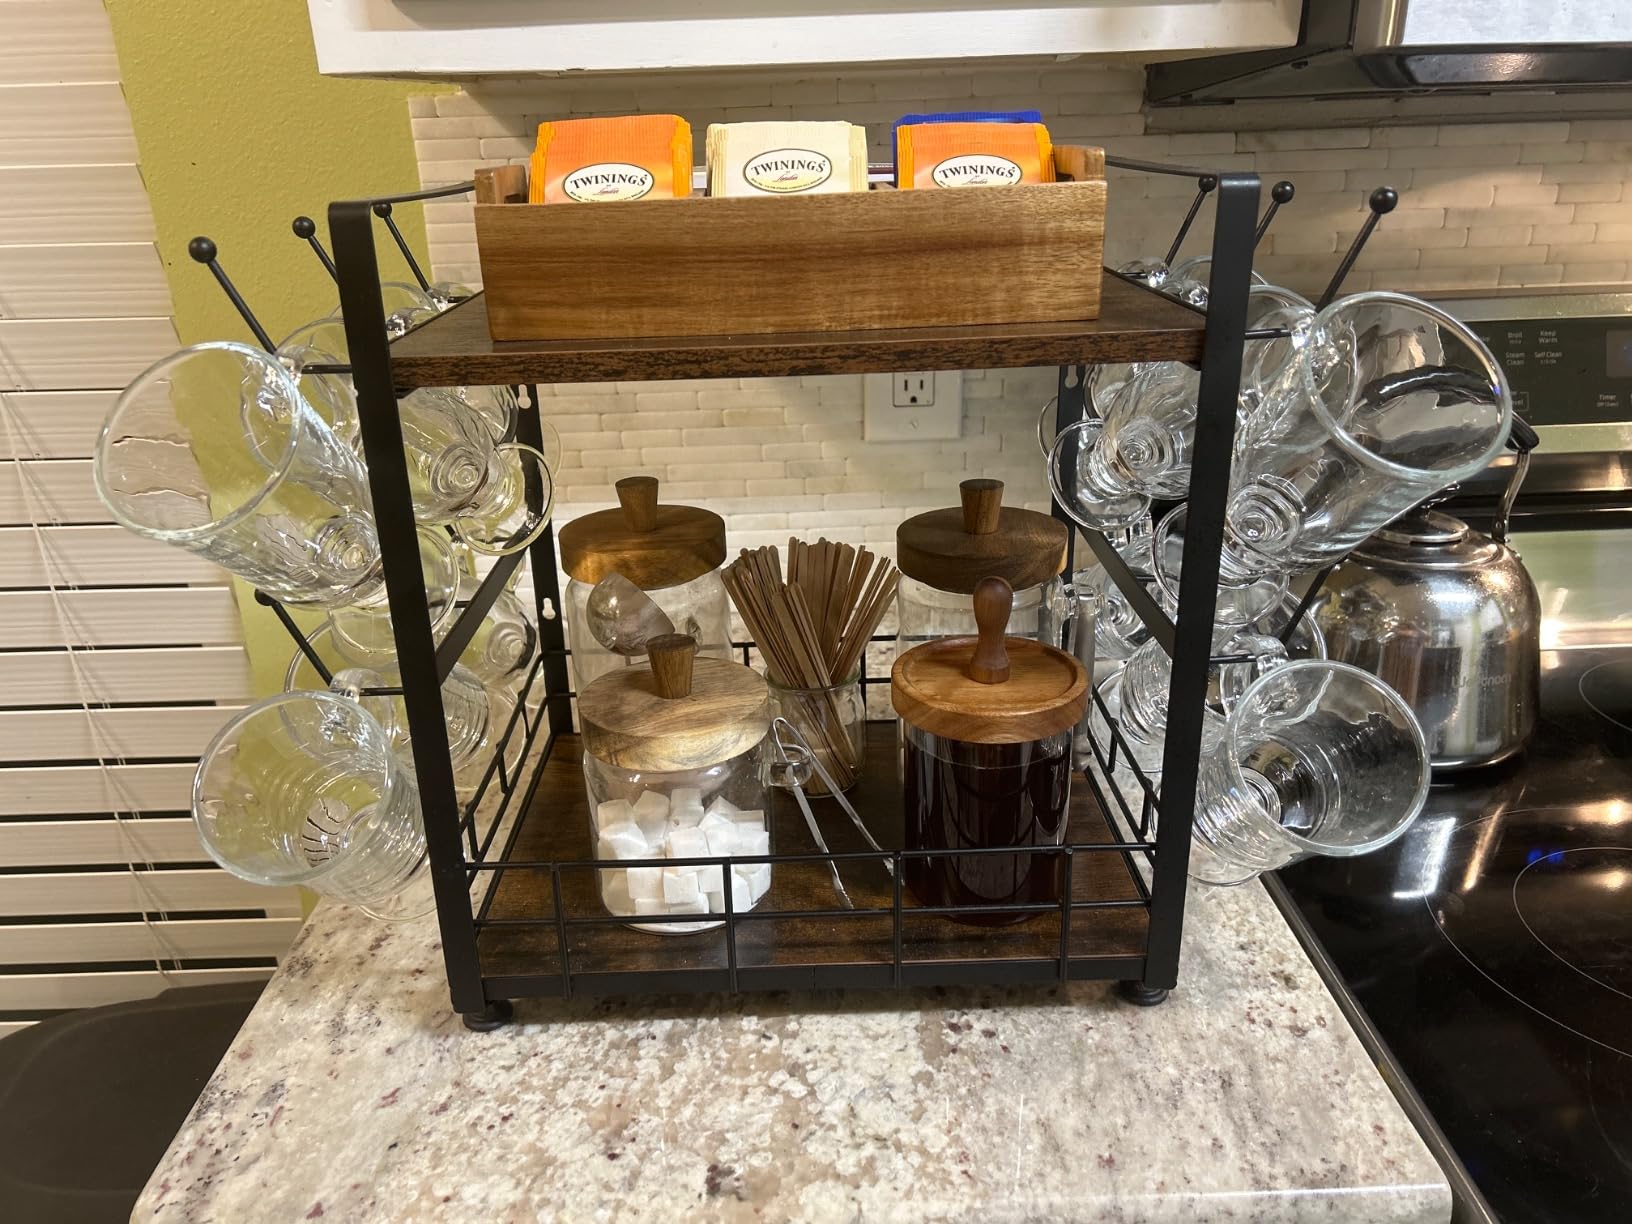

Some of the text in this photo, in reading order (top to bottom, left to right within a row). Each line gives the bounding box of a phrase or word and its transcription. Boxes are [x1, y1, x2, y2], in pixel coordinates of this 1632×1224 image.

[751, 160, 825, 175] TWININGS
[939, 165, 1015, 179] TWININGS
[570, 174, 648, 189] TWININGS
